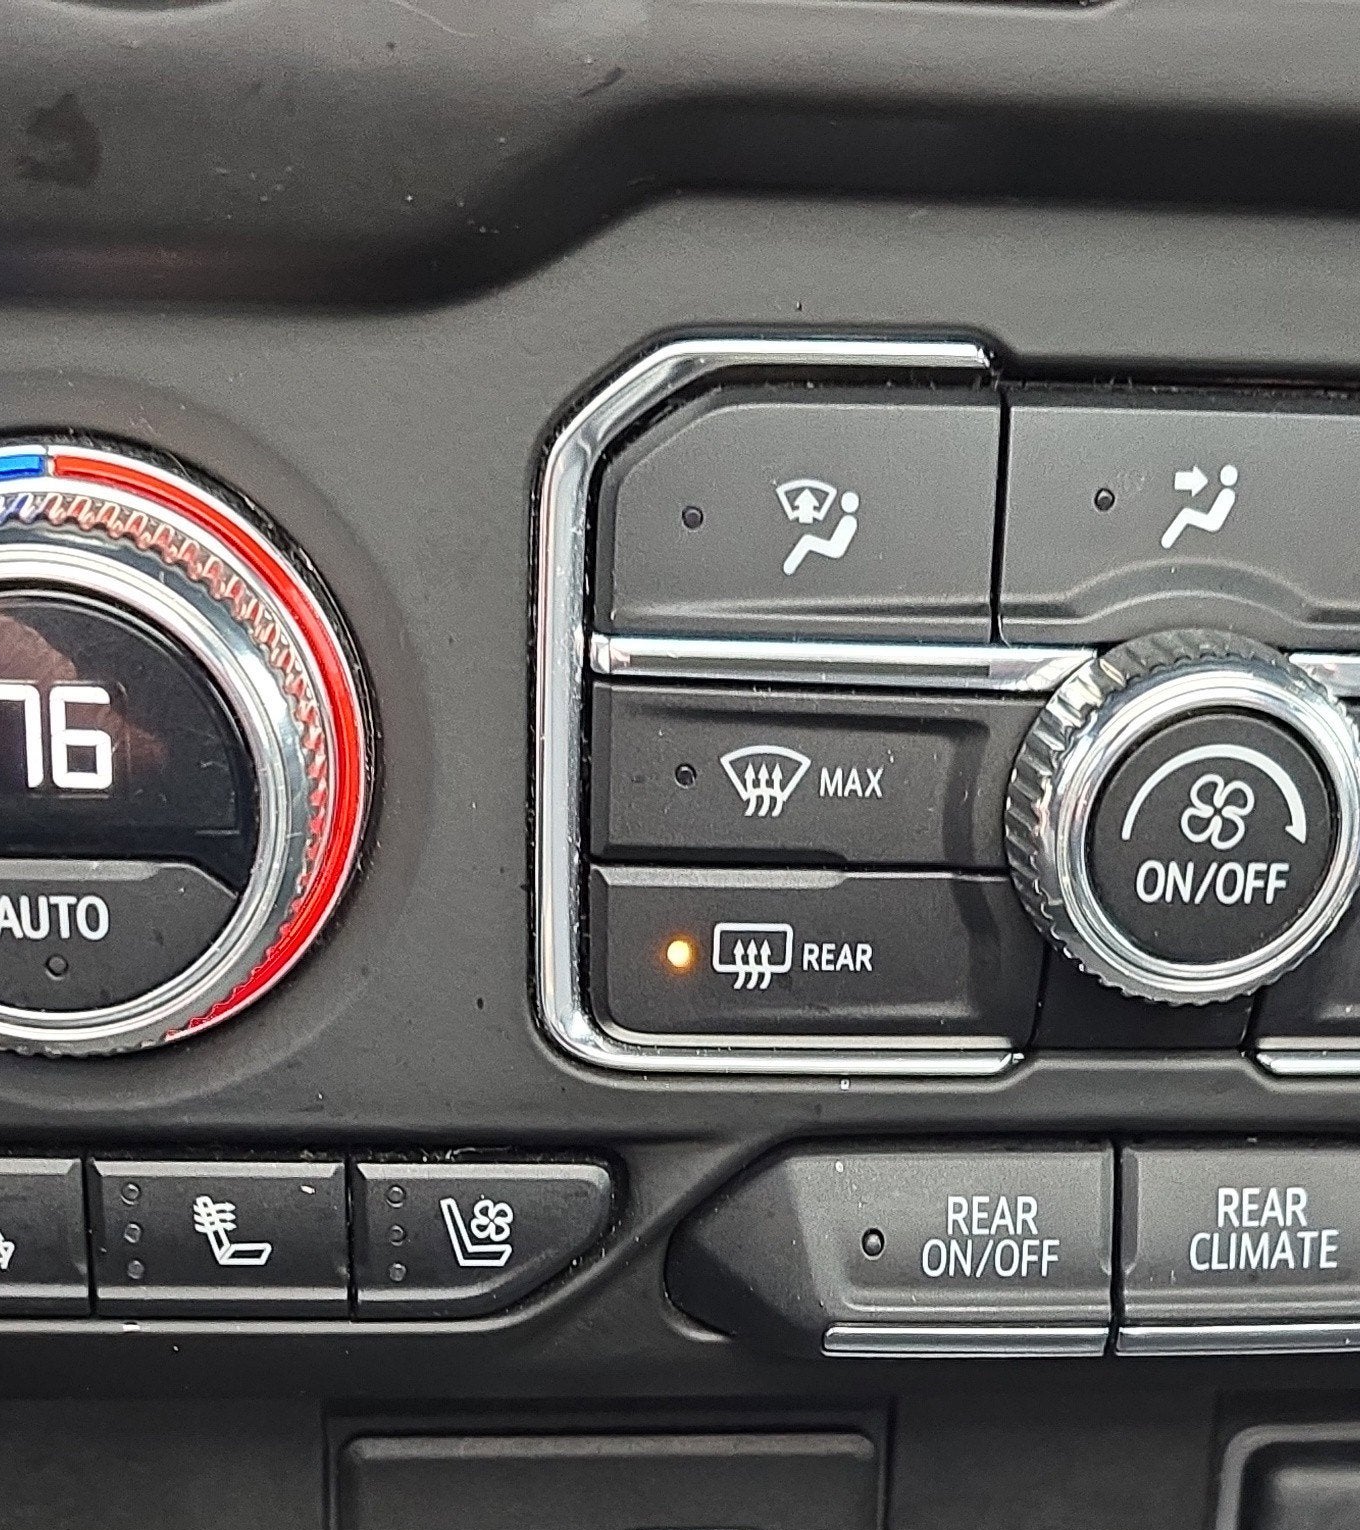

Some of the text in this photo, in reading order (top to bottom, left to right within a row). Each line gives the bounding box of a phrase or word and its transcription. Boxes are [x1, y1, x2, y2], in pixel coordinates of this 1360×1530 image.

[818, 765, 884, 799] MAX
[1134, 859, 1291, 906] ON/OFF
[800, 942, 874, 973] REAR
[946, 1195, 1040, 1237] REAR
[1216, 1186, 1309, 1228] REAR
[921, 1237, 1062, 1279] ON/OFF
[1188, 1228, 1340, 1271] CLIMATE
